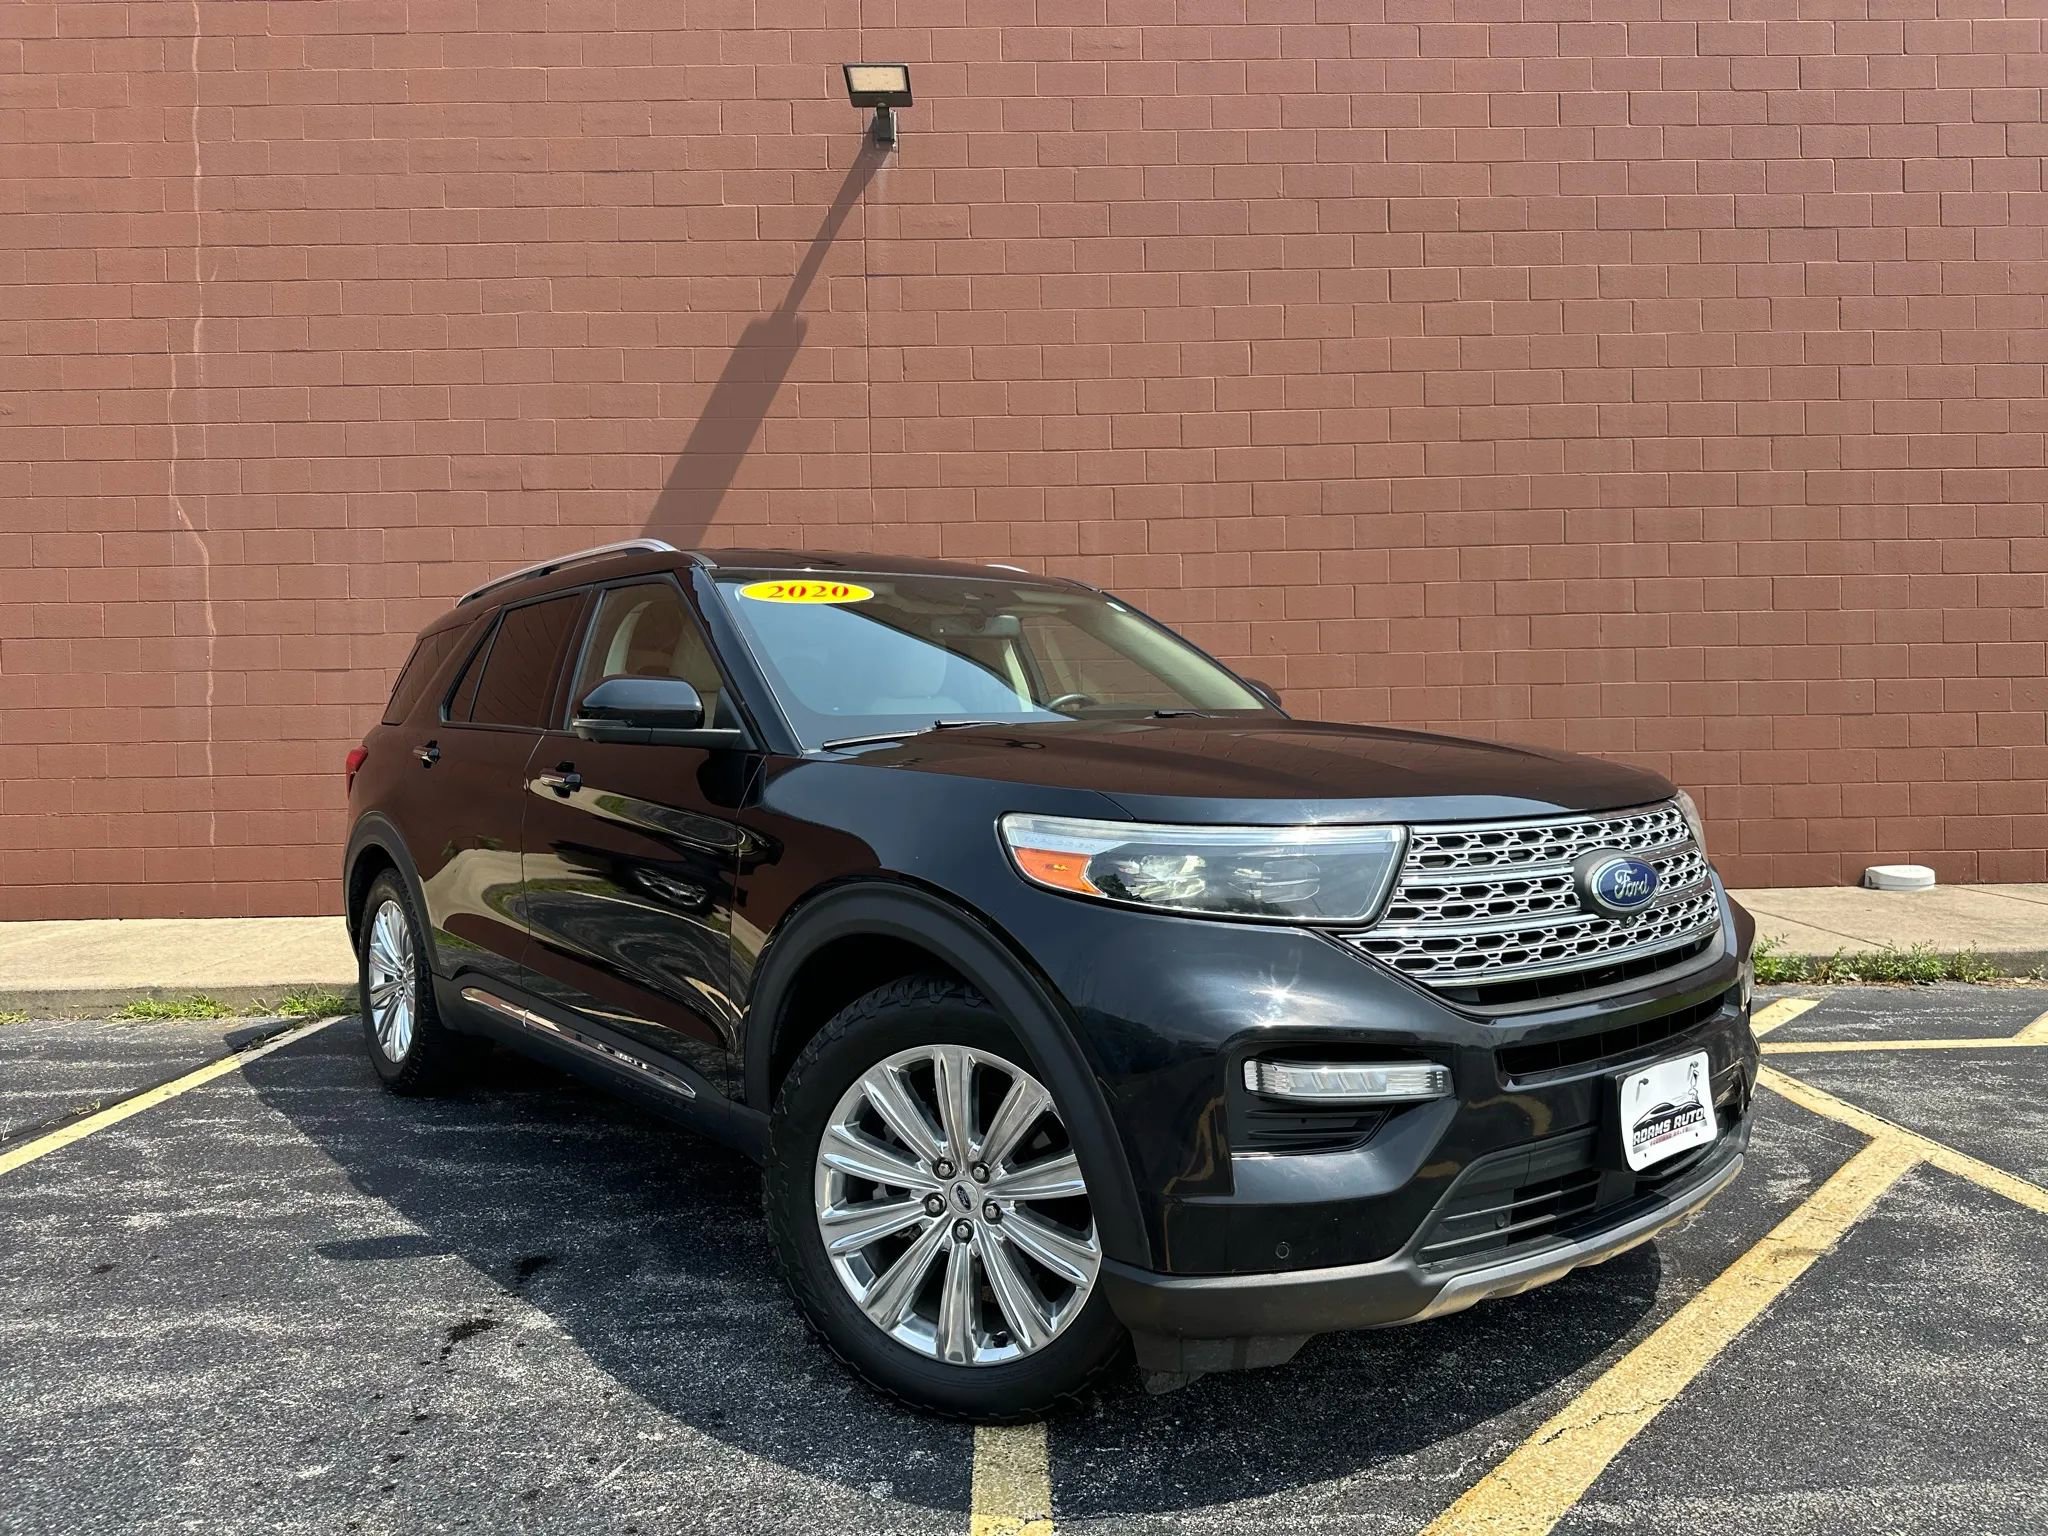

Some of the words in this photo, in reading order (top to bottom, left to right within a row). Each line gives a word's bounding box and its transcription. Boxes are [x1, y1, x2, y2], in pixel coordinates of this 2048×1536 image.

[768, 585, 849, 598] 2020
[1614, 868, 1650, 899] Ford
[1633, 1118, 1671, 1146] ADAMS
[1673, 1109, 1705, 1129] AUTO
